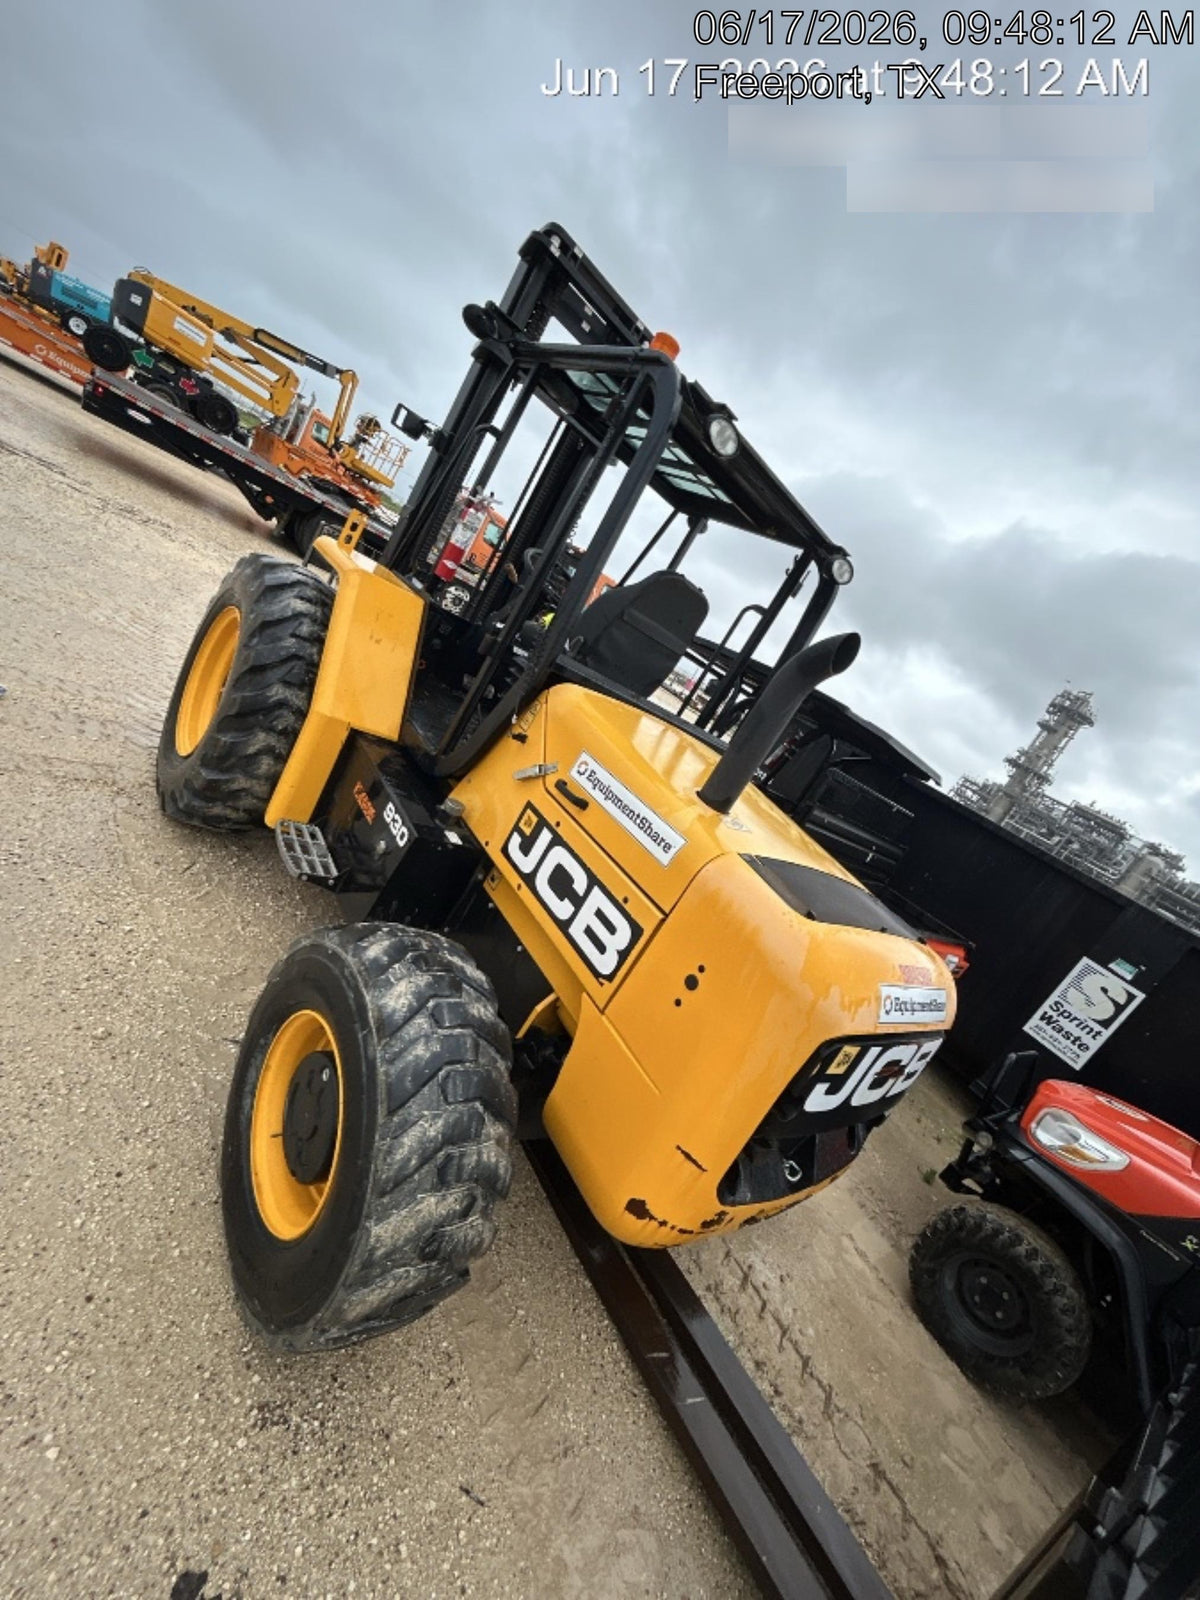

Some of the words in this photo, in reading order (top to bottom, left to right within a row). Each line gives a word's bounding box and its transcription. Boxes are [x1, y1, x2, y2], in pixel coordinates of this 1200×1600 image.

[383, 801, 409, 848] 930
[585, 768, 673, 854] EquipmentShare
[507, 826, 632, 976] JCB
[1038, 1010, 1091, 1053] Waste
[1048, 1000, 1104, 1041] Sprint
[803, 1038, 943, 1113] JCB
